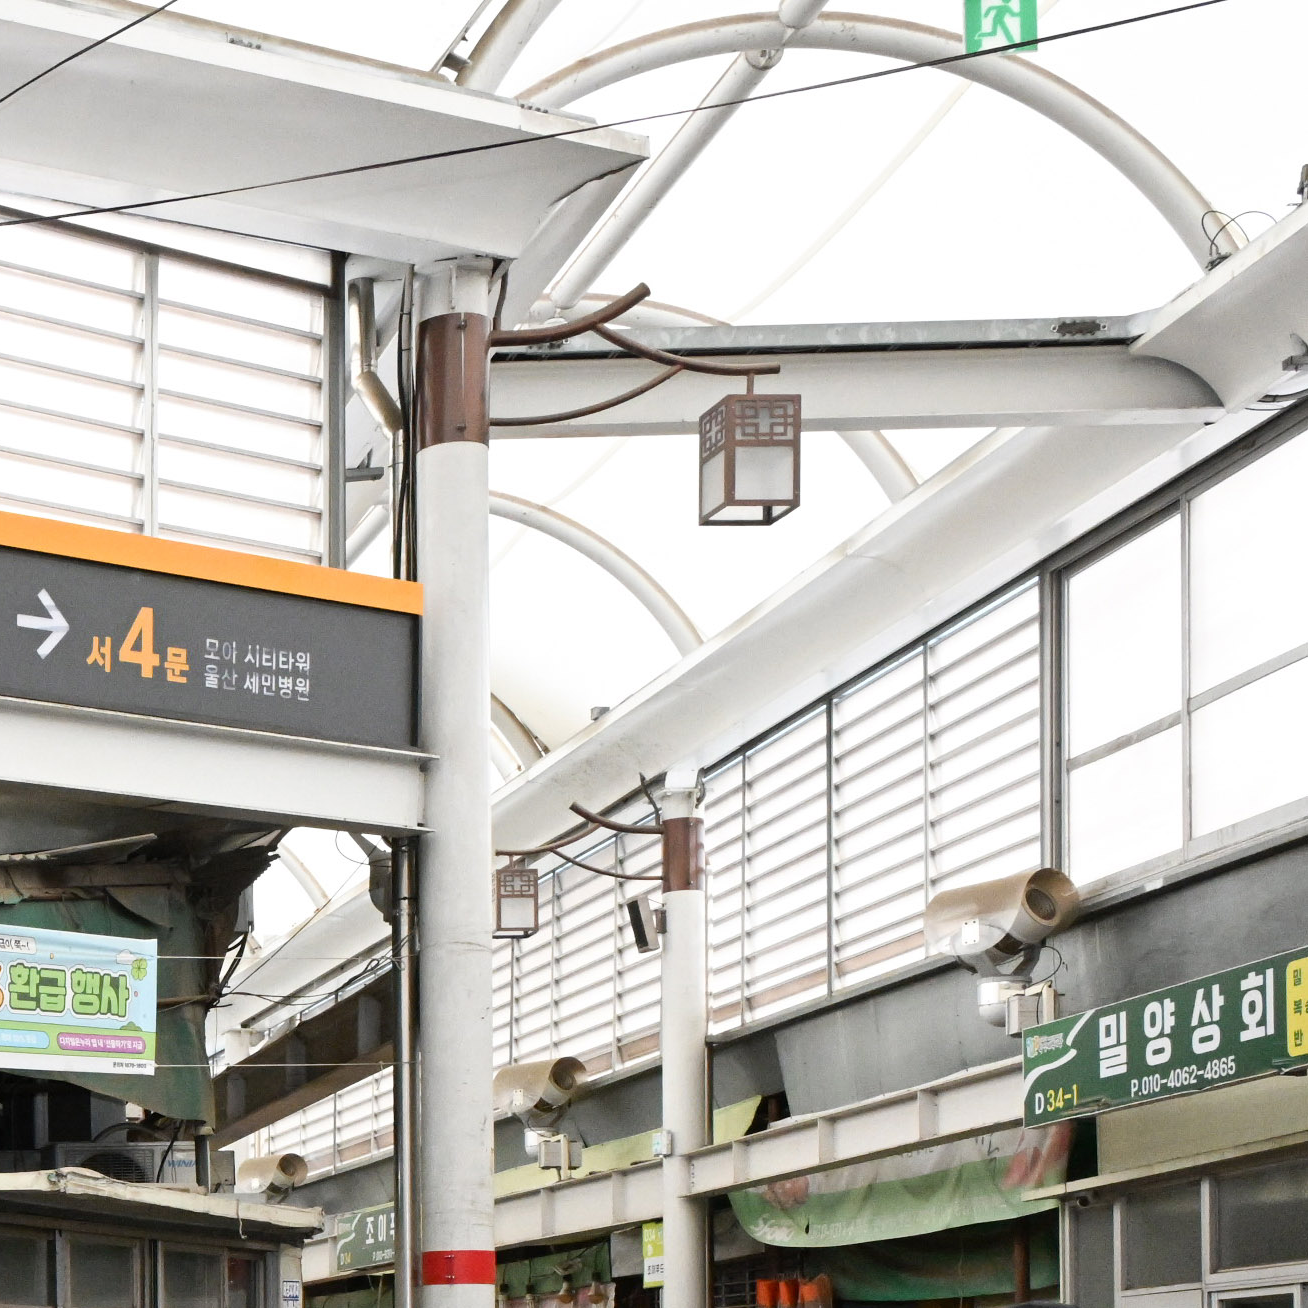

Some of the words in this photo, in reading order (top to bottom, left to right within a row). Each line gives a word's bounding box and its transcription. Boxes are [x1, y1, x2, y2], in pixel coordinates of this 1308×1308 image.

[204, 638, 237, 664] 모아
[244, 644, 310, 675] 시티타워
[204, 664, 237, 690] 울산
[244, 671, 310, 702] 세민병원
[8, 963, 67, 1012] 환급
[71, 968, 129, 1017] 행사
[1099, 968, 1275, 1079] 밀양상회
[1131, 1055, 1236, 1098] P.010-4062-4865
